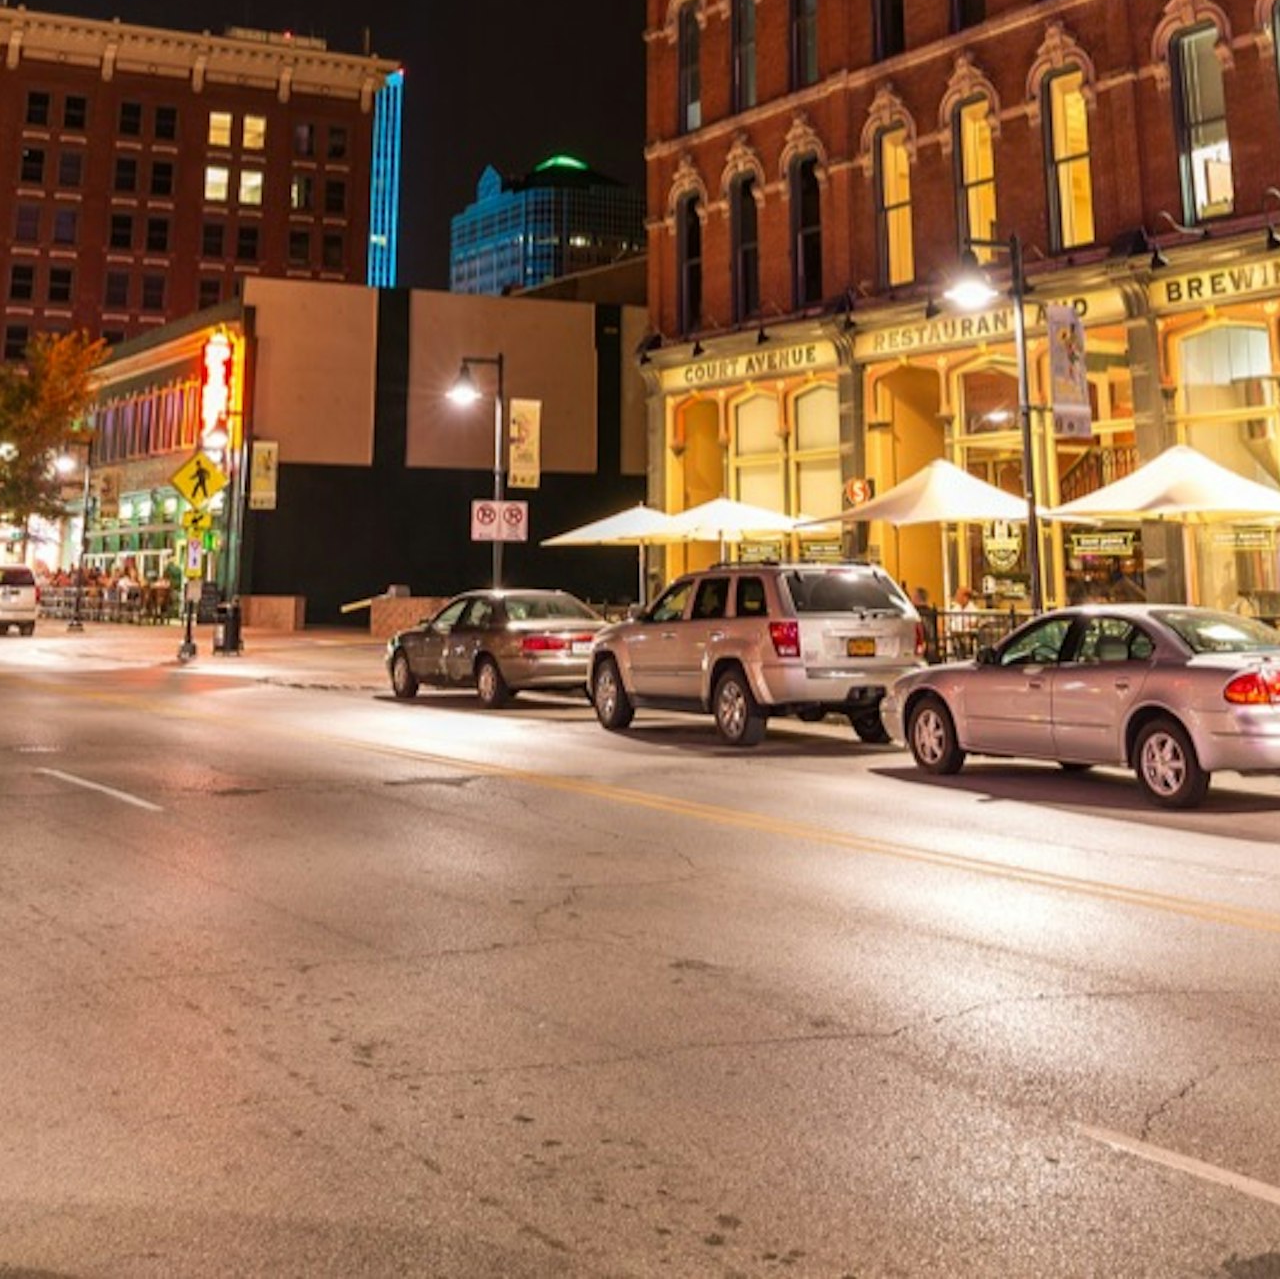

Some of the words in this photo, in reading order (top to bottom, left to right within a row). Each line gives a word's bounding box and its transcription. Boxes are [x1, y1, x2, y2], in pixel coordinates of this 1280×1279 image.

[872, 309, 1017, 353] RESTAURAN
[1035, 297, 1088, 325] AD
[683, 360, 739, 383] COURT
[744, 344, 817, 374] AVENUE
